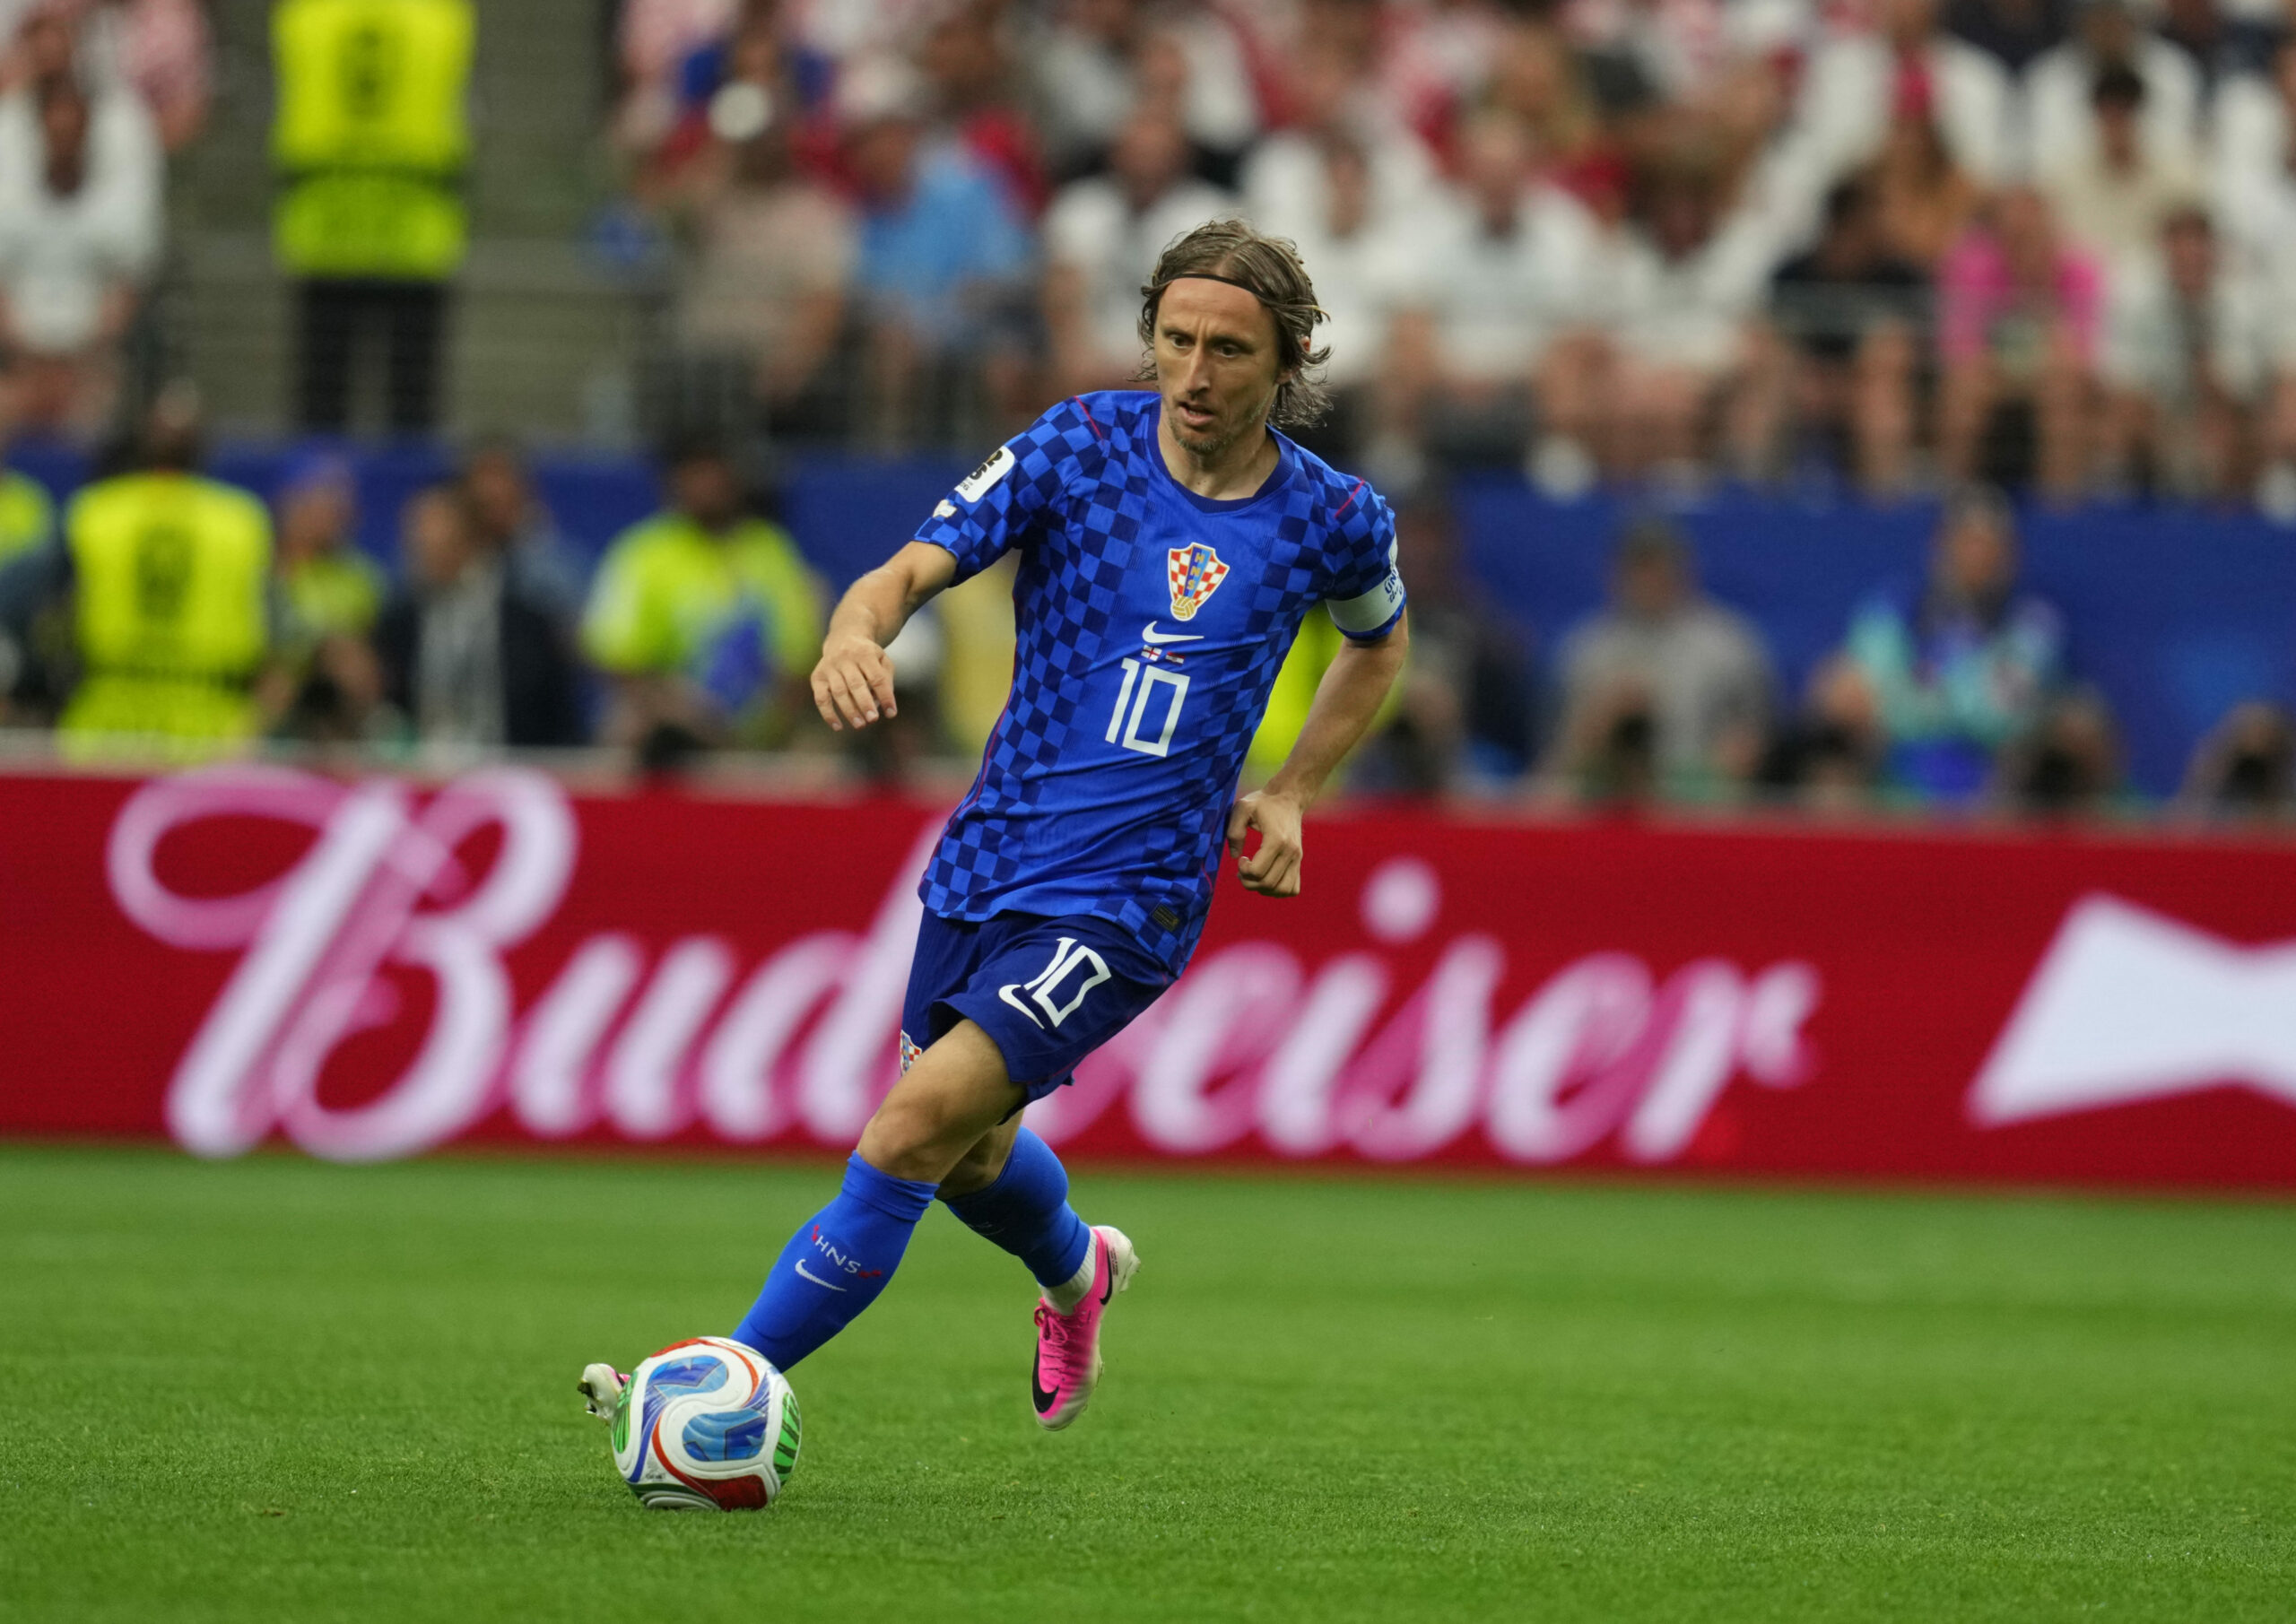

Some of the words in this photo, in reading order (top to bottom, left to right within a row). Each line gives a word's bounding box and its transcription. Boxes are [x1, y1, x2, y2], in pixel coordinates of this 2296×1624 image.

[1186, 552, 1205, 591] HNS
[1105, 657, 1191, 758] 10
[105, 763, 1822, 1164] Budeiser
[1023, 936, 1112, 1029] 10
[814, 1235, 861, 1273] HNS
